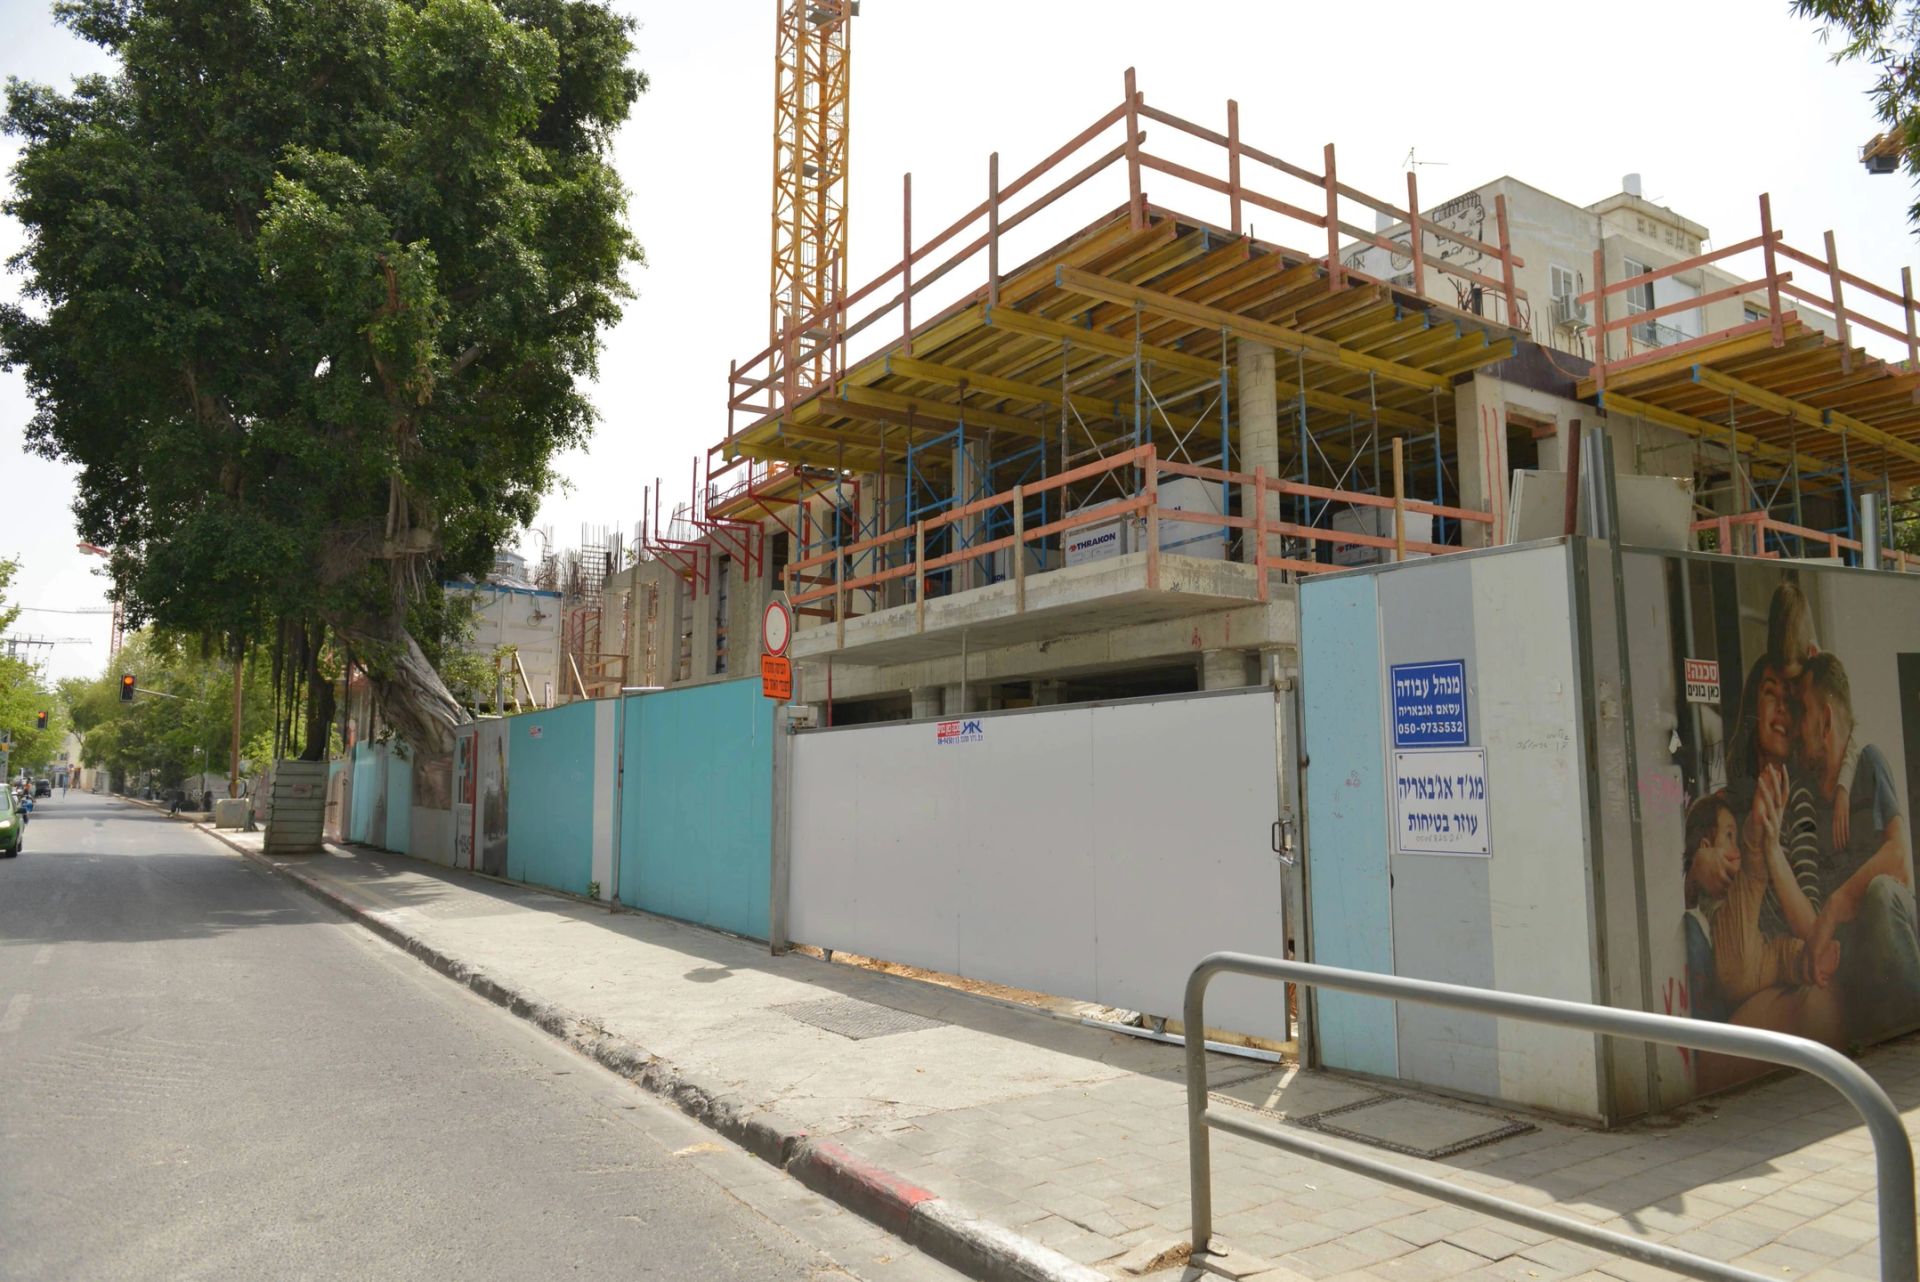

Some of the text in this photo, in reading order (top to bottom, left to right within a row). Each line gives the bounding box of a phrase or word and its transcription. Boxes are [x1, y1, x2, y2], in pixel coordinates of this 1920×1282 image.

[1077, 532, 1116, 551] THRAKON
[1687, 662, 1717, 681] סכנה!
[1397, 674, 1460, 699] מנהל עבודה
[1687, 684, 1719, 701] כאן בונים
[1398, 703, 1460, 717] עסאם אגבאריה
[1398, 774, 1484, 800] מג'ד אג'באריה
[1408, 812, 1478, 837] עוזר בטיחות
